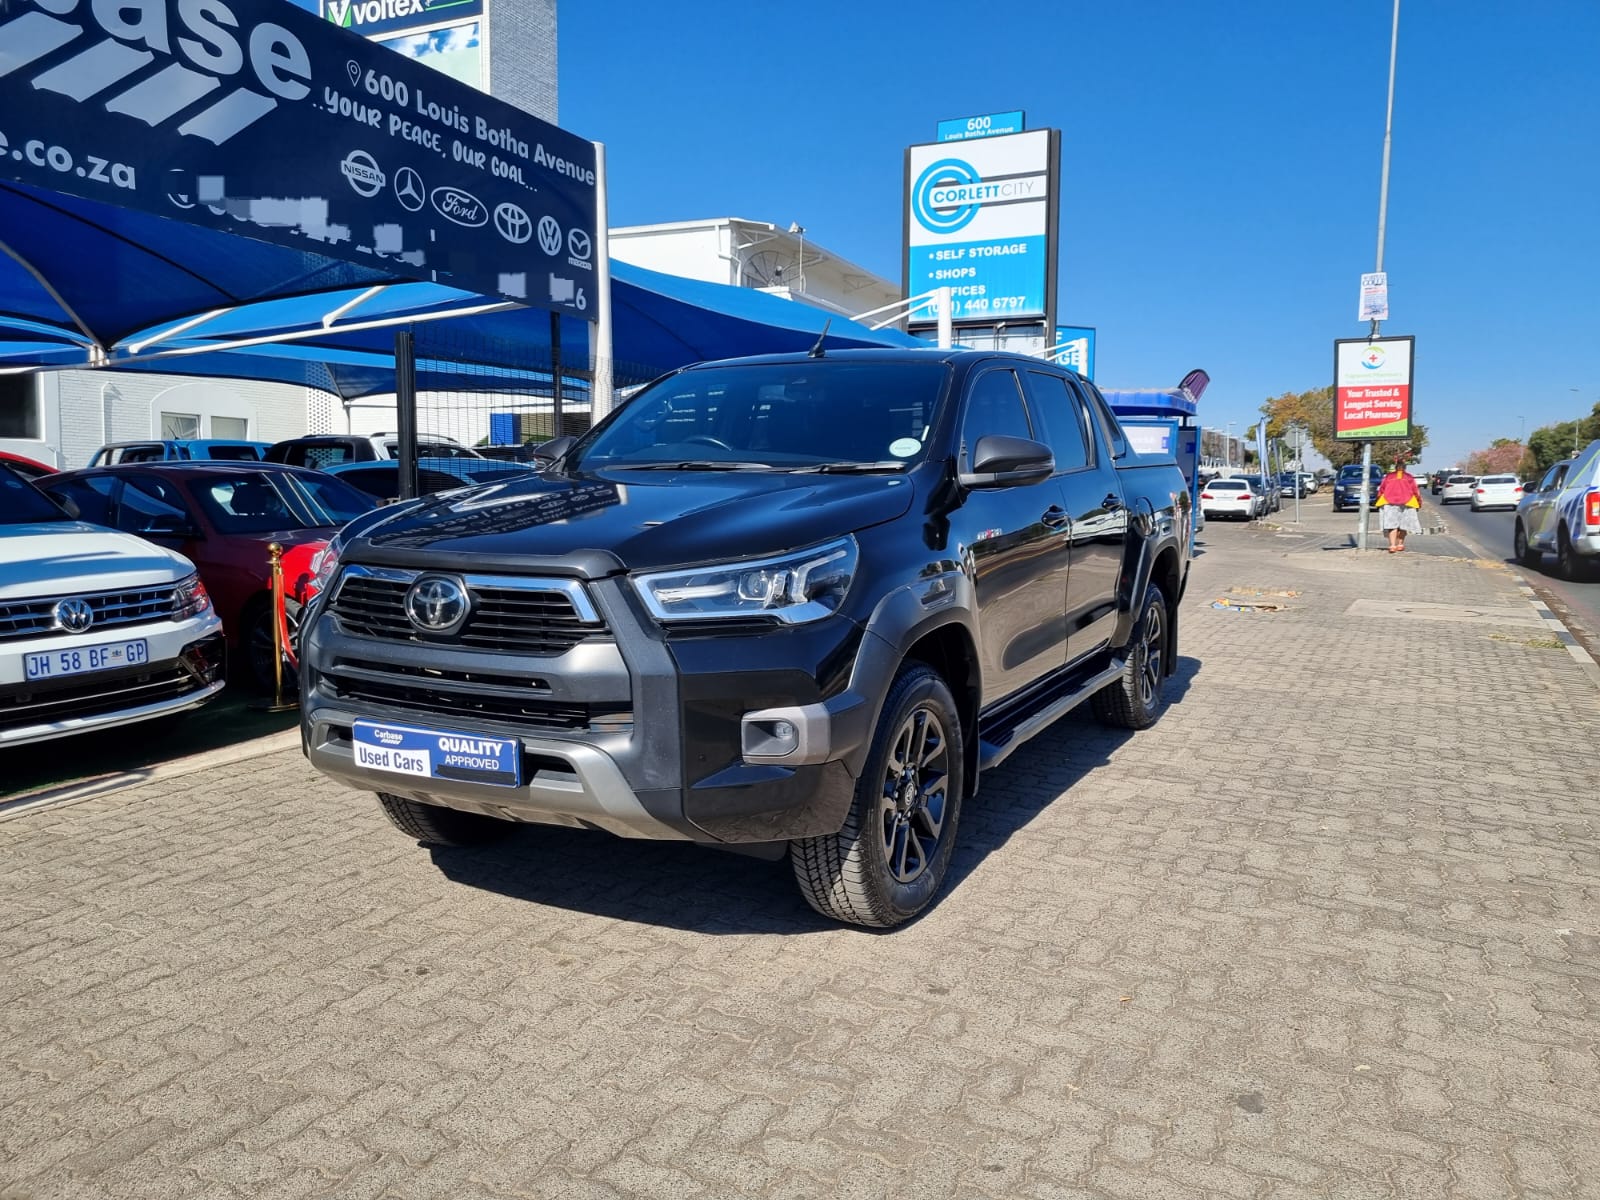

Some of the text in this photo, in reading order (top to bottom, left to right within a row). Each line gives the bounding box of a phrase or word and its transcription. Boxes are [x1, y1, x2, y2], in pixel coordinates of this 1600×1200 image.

[33, 0, 312, 101] ase
[364, 69, 595, 187] 600 Louis Botha Avenue
[967, 116, 992, 130] 600
[944, 126, 1014, 141] Louis Botha Avenue
[389, 113, 447, 158] PEACE,
[452, 139, 486, 171] OUR
[343, 163, 385, 184] NISSAN
[442, 192, 479, 221] Ford
[936, 243, 1028, 261] SELF STORAGE
[935, 267, 977, 280] SHOPS
[951, 284, 986, 297] FICES
[964, 298, 989, 310] 440
[992, 295, 1026, 309] 6797
[1346, 389, 1364, 398] Your
[1364, 388, 1393, 398] Trusted
[1343, 399, 1402, 410] Longest Serving
[1343, 410, 1402, 420] Local Pharmacy
[29, 642, 145, 676] JH 58 BF GP
[374, 729, 403, 741] Carbase
[438, 737, 503, 757] QUALITY
[359, 746, 424, 773] Used Cars
[444, 755, 500, 771] APPROVED
